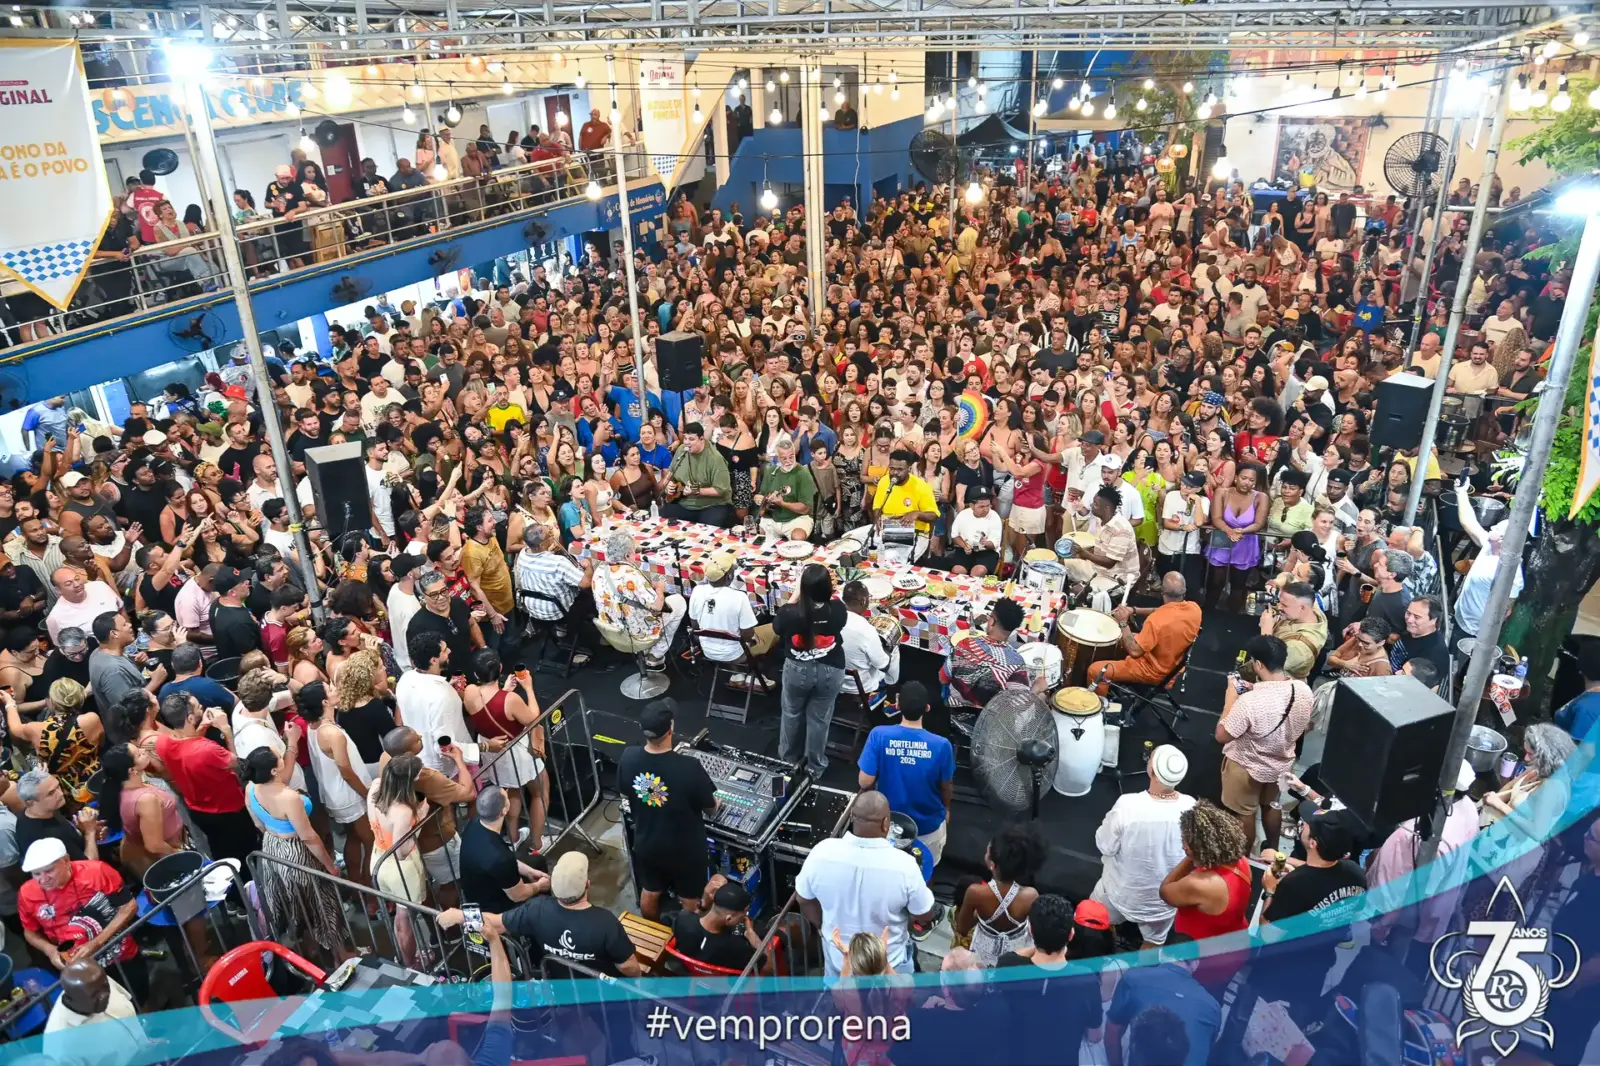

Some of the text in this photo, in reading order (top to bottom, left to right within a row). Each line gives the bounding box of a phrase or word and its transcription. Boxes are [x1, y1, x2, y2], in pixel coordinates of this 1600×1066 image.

[43, 141, 68, 157] DA
[10, 161, 22, 179] É
[24, 163, 39, 177] O
[41, 158, 89, 176] POVO
[889, 739, 928, 750] PORTELINHA
[885, 747, 932, 759] RIO DE JANEIRO
[900, 756, 916, 765] 2025
[1307, 897, 1332, 918] DEUS
[1328, 889, 1340, 903] EX
